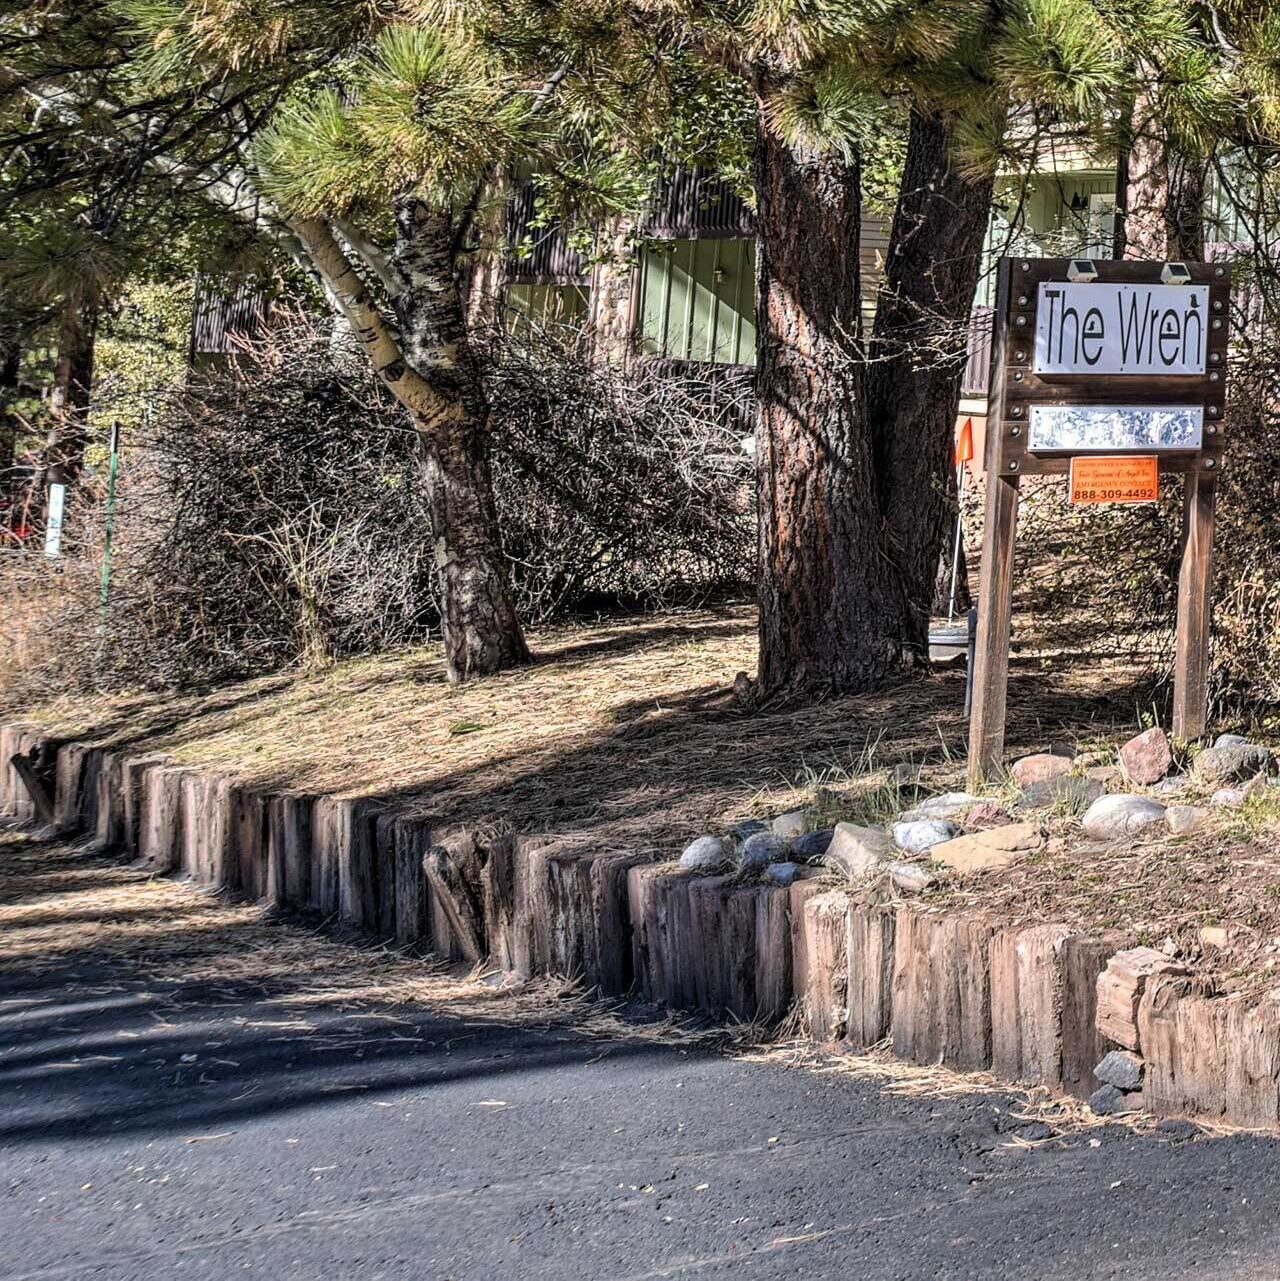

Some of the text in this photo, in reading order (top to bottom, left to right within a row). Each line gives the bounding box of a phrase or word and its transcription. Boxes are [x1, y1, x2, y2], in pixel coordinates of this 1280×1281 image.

[1045, 290, 1200, 365] The Wren
[1074, 489, 1153, 499] 888-309-4492
